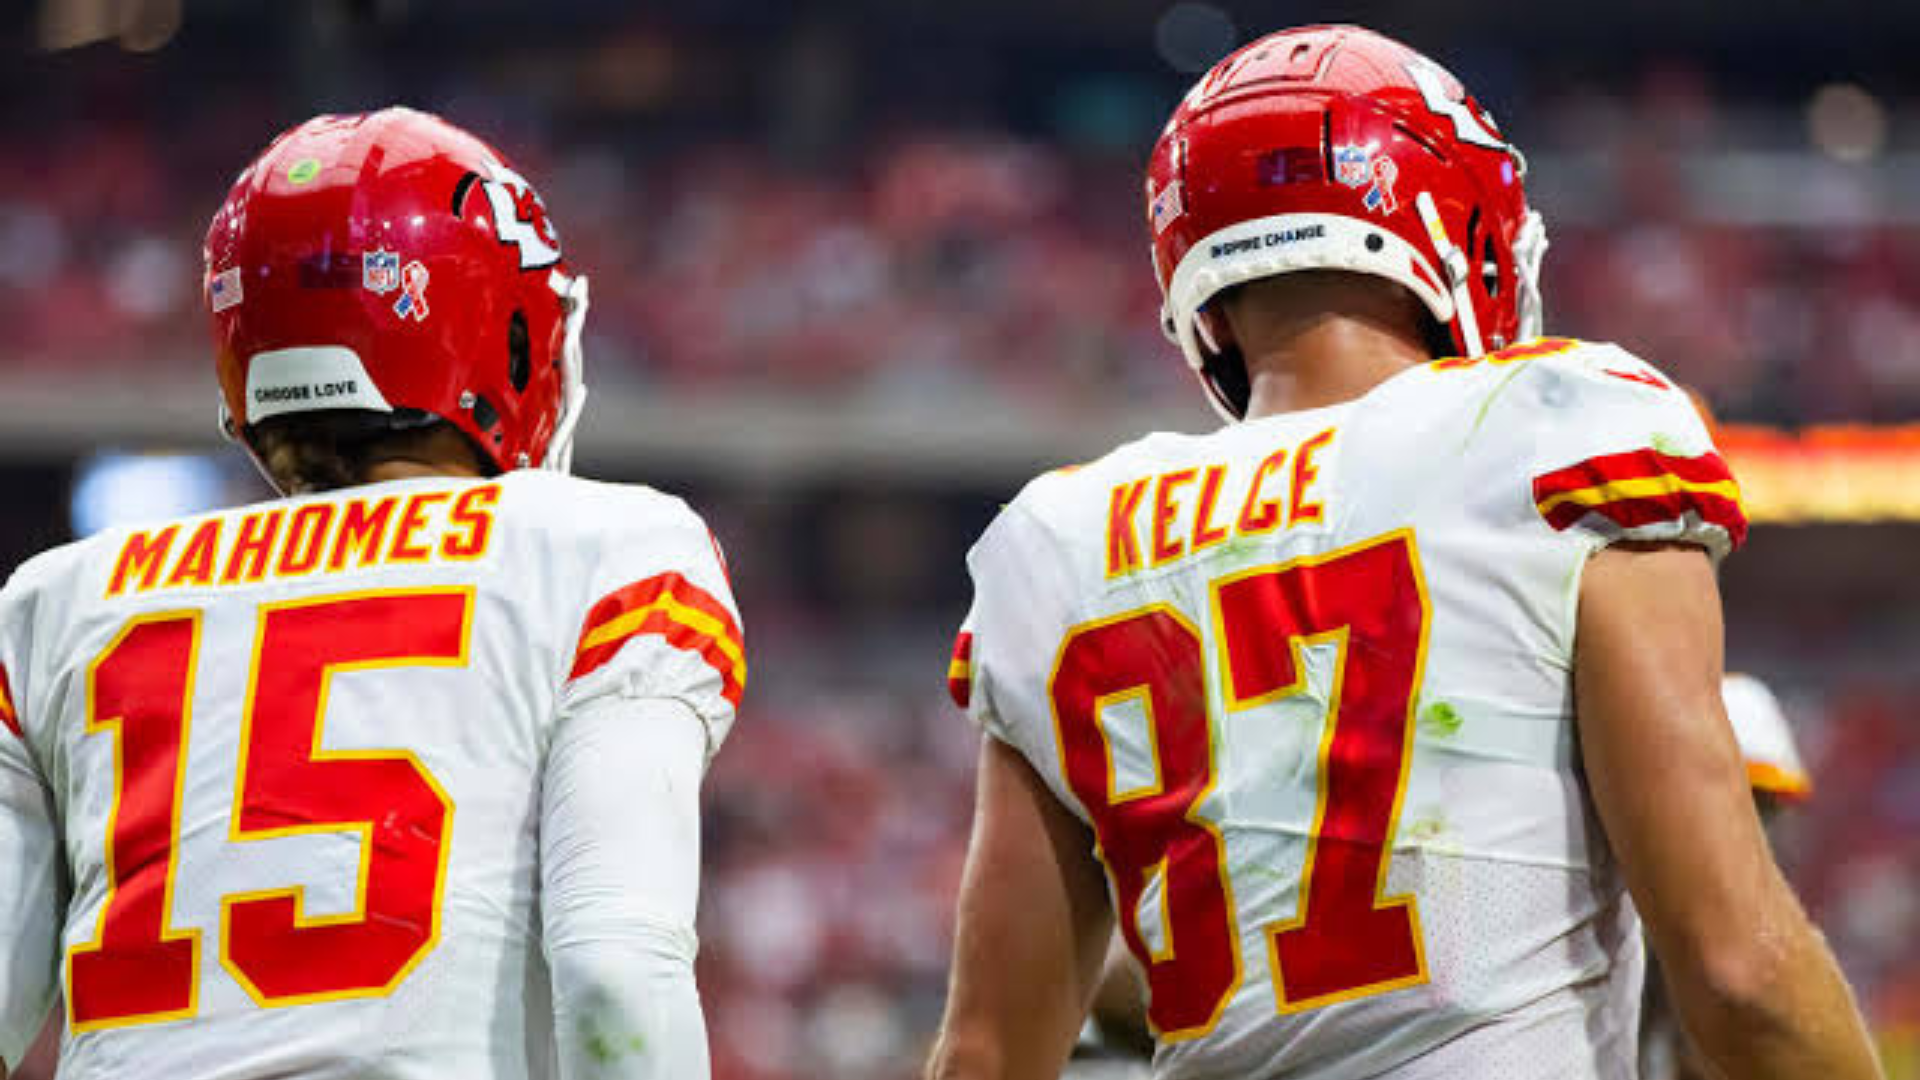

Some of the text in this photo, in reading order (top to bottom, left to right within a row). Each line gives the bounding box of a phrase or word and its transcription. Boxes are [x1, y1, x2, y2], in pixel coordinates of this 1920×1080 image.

[1264, 224, 1326, 248] CHANGE
[254, 380, 358, 402] CHOOSE LOVE
[105, 484, 502, 599] MAHOMES
[67, 586, 476, 1034] 15
[1048, 528, 1432, 1042] 87
